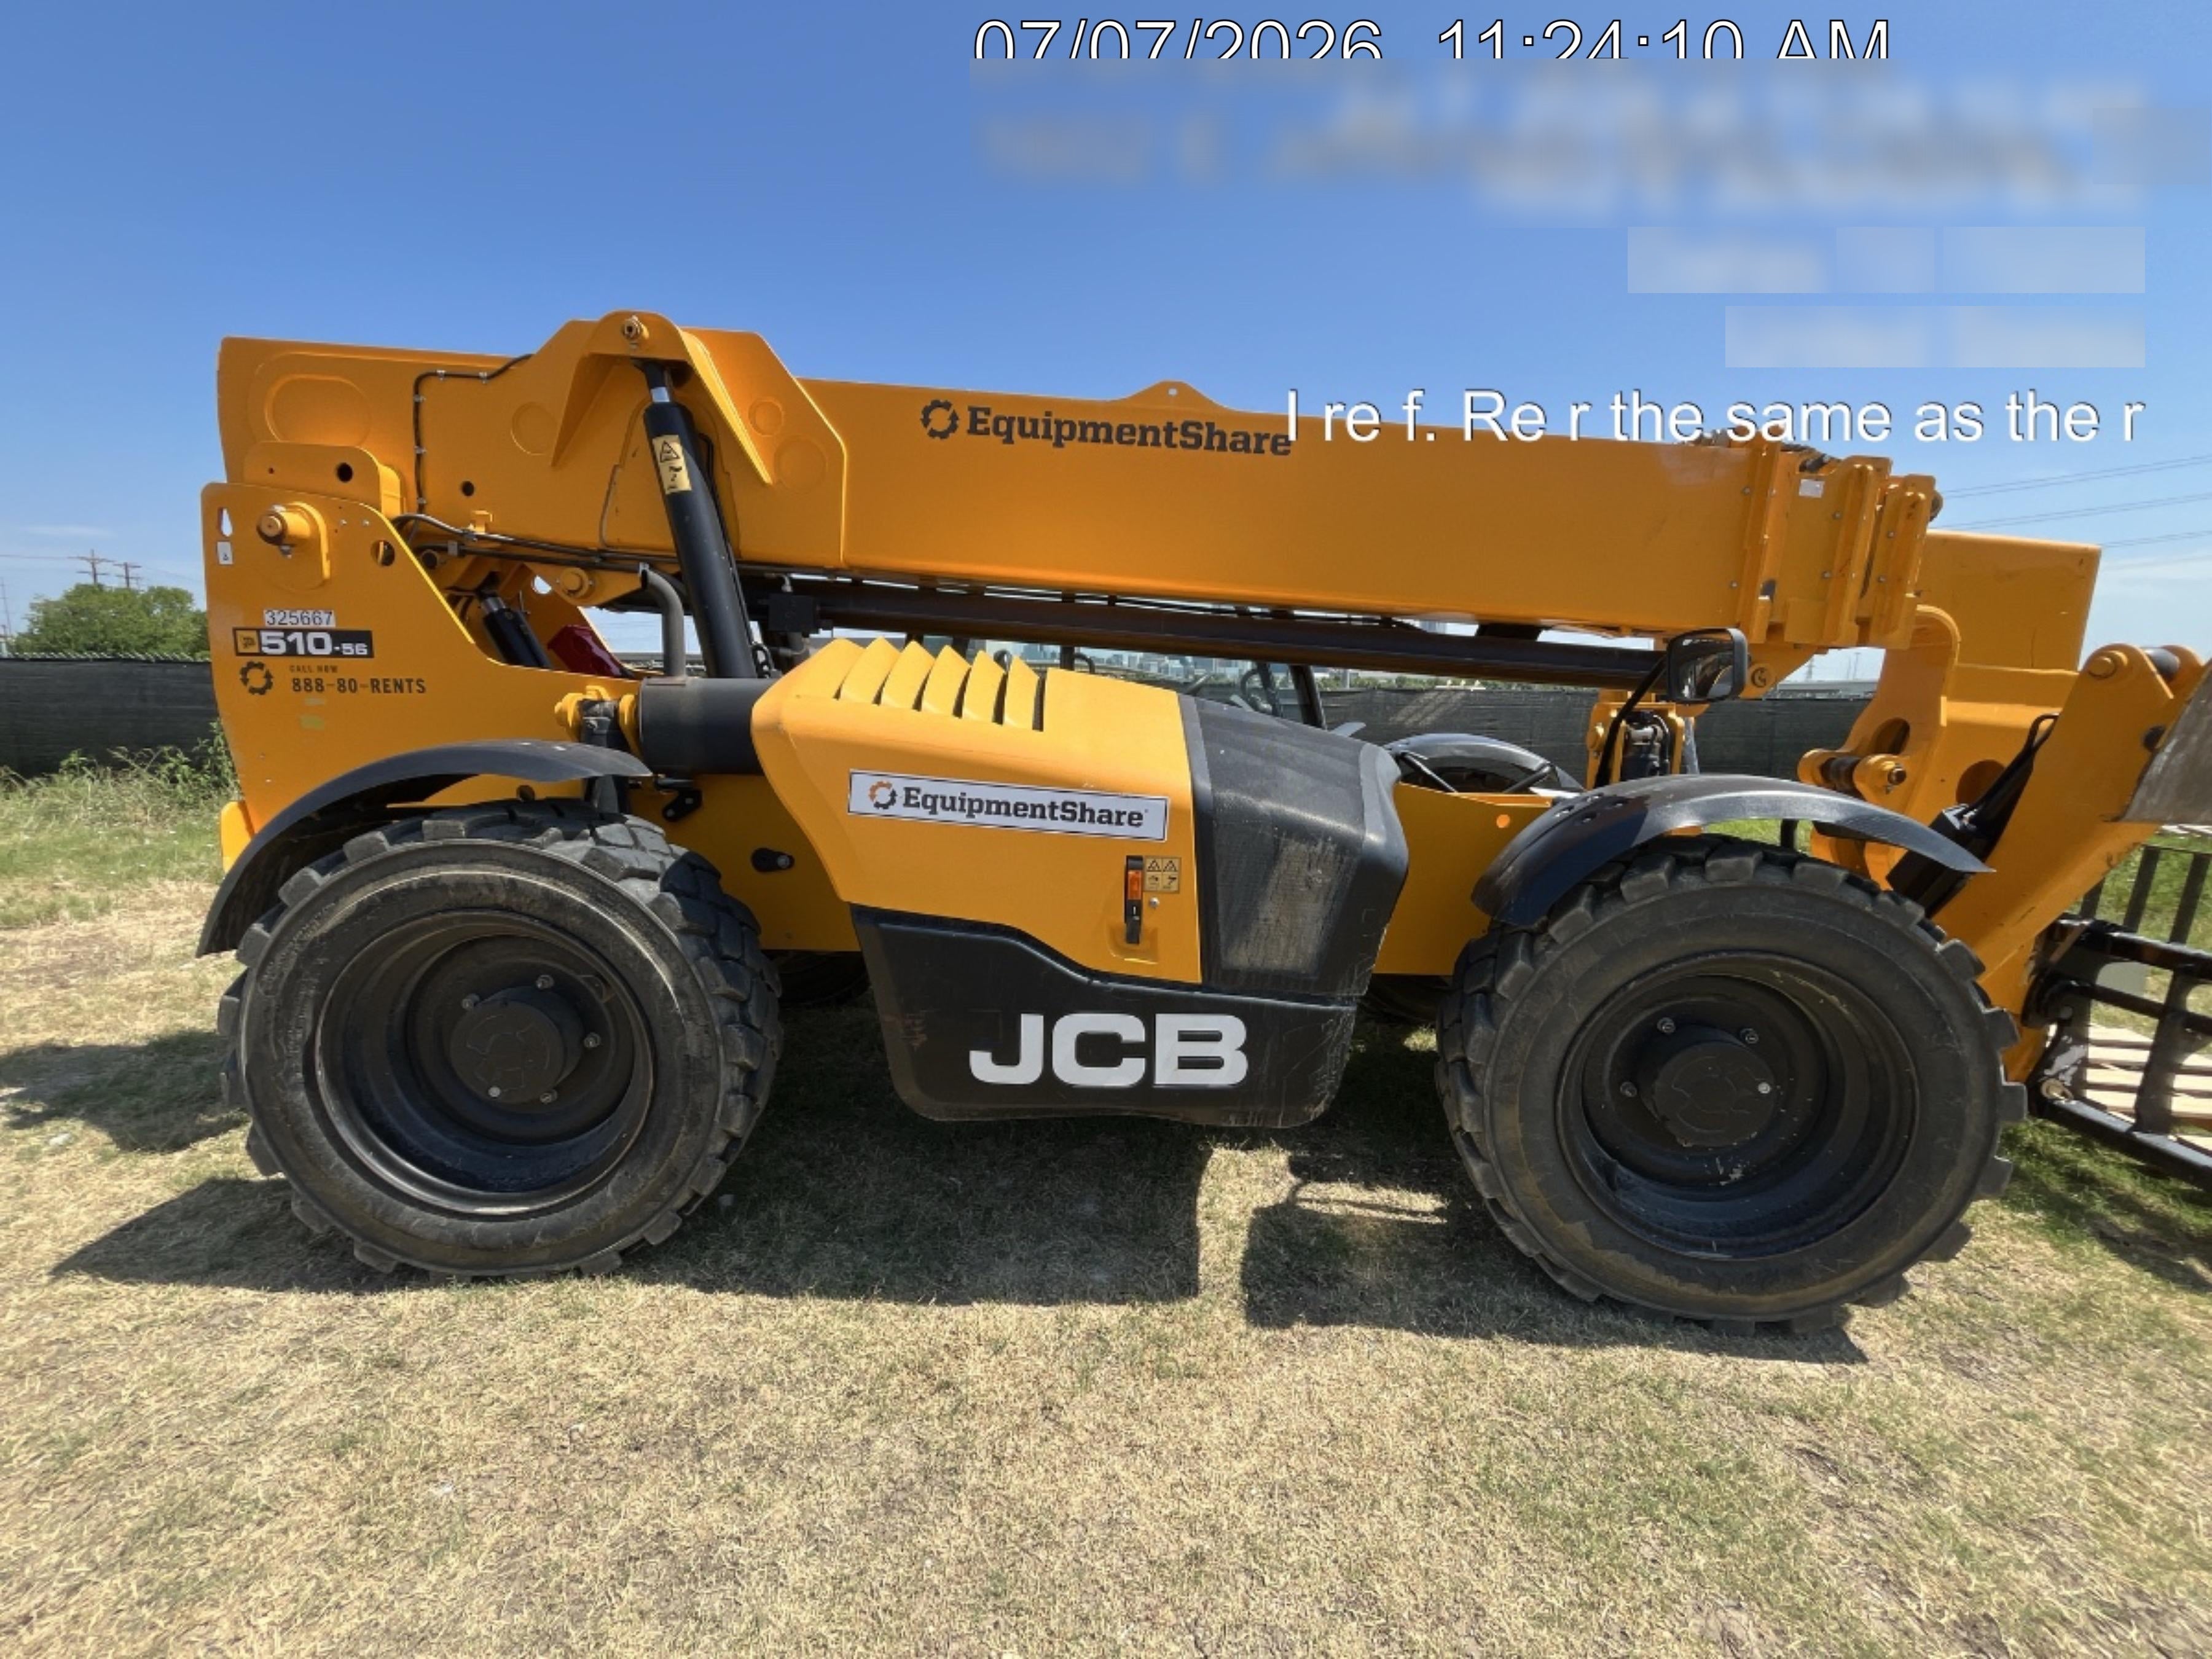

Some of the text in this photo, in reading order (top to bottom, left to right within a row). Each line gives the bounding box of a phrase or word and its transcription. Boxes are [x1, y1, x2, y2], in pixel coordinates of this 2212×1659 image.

[967, 406, 1291, 456] EquipmentShare
[265, 610, 332, 626] 325667
[260, 630, 368, 656] 510-56
[292, 678, 426, 694] 888-80-RENTS
[903, 786, 1144, 828] EquipmentShare
[969, 1013, 1249, 1088] JCB
